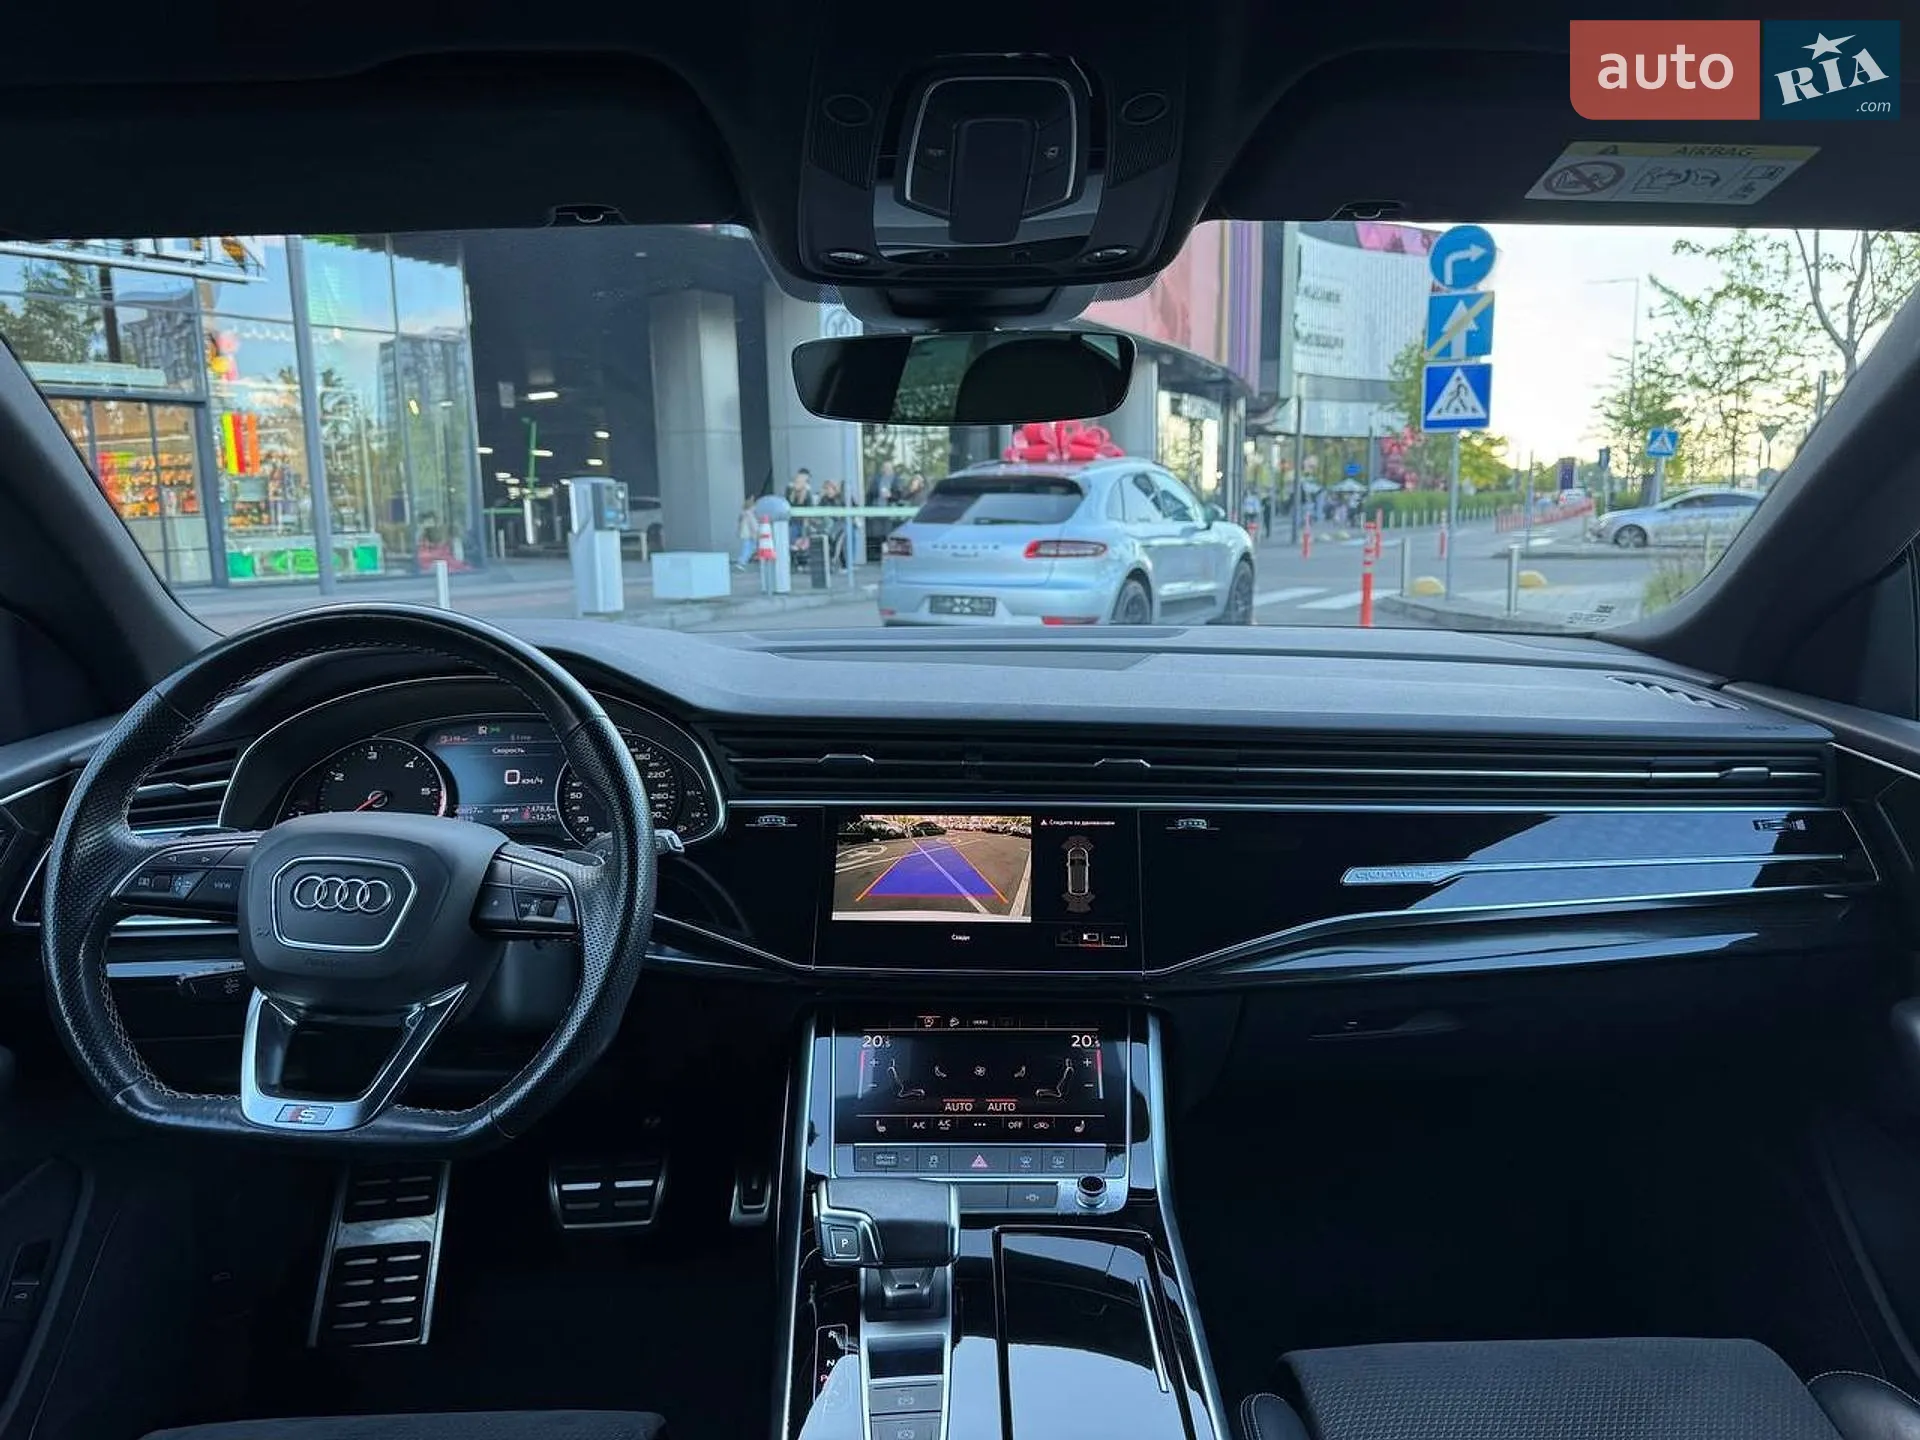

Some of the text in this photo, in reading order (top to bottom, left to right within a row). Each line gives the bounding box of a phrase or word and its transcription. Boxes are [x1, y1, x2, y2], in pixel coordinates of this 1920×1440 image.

[1673, 144, 1757, 157] AIRBAG
[366, 751, 379, 760] 3
[334, 772, 345, 782] 2
[504, 769, 521, 786] 0
[647, 771, 666, 779] 220
[569, 791, 583, 800] 50
[944, 1102, 974, 1112] AUTO
[987, 1102, 1017, 1112] AUTO
[911, 1121, 927, 1130] A/C
[1007, 1121, 1023, 1130] OFF
[841, 1239, 849, 1248] P
[826, 1358, 836, 1367] N
